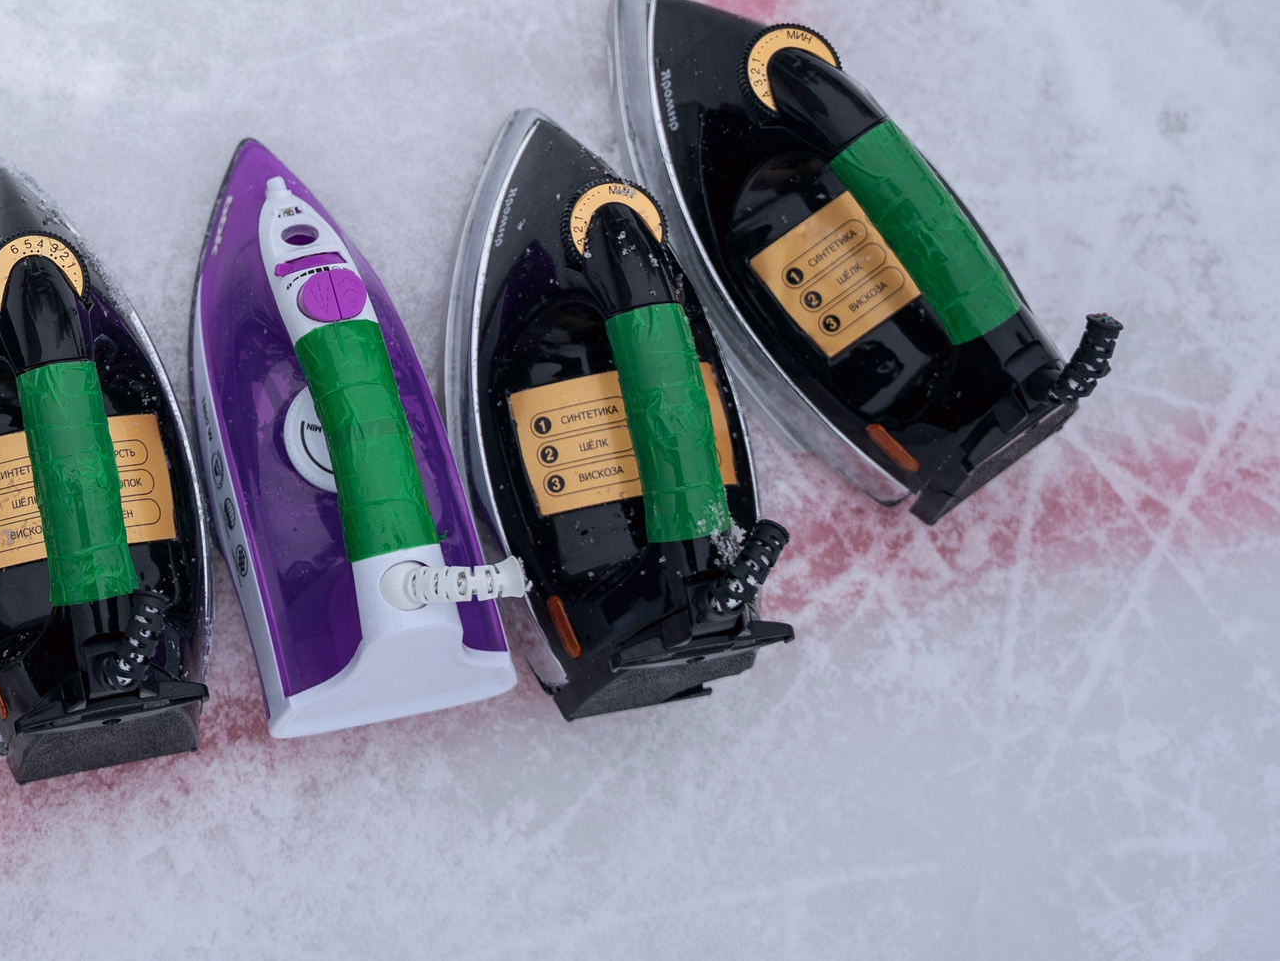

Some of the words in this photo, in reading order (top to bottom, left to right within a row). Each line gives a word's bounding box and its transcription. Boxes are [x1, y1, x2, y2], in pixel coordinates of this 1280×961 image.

[753, 79, 763, 87] 3
[786, 30, 813, 44] МИН
[10, 244, 19, 254] 6
[24, 239, 32, 249] 5
[37, 239, 44, 248] 4
[50, 243, 59, 253] 3
[59, 251, 70, 261] 2
[808, 229, 858, 267] СИНТЕТИКА
[848, 281, 888, 313] ВИСКОЗА
[560, 405, 619, 424] СИНТЕТИКА
[306, 423, 322, 433] MIN
[545, 448, 554, 461] 2
[551, 477, 561, 490] 3
[578, 466, 624, 482] ВИСКОЗА
[10, 525, 43, 541] ВИСКО
